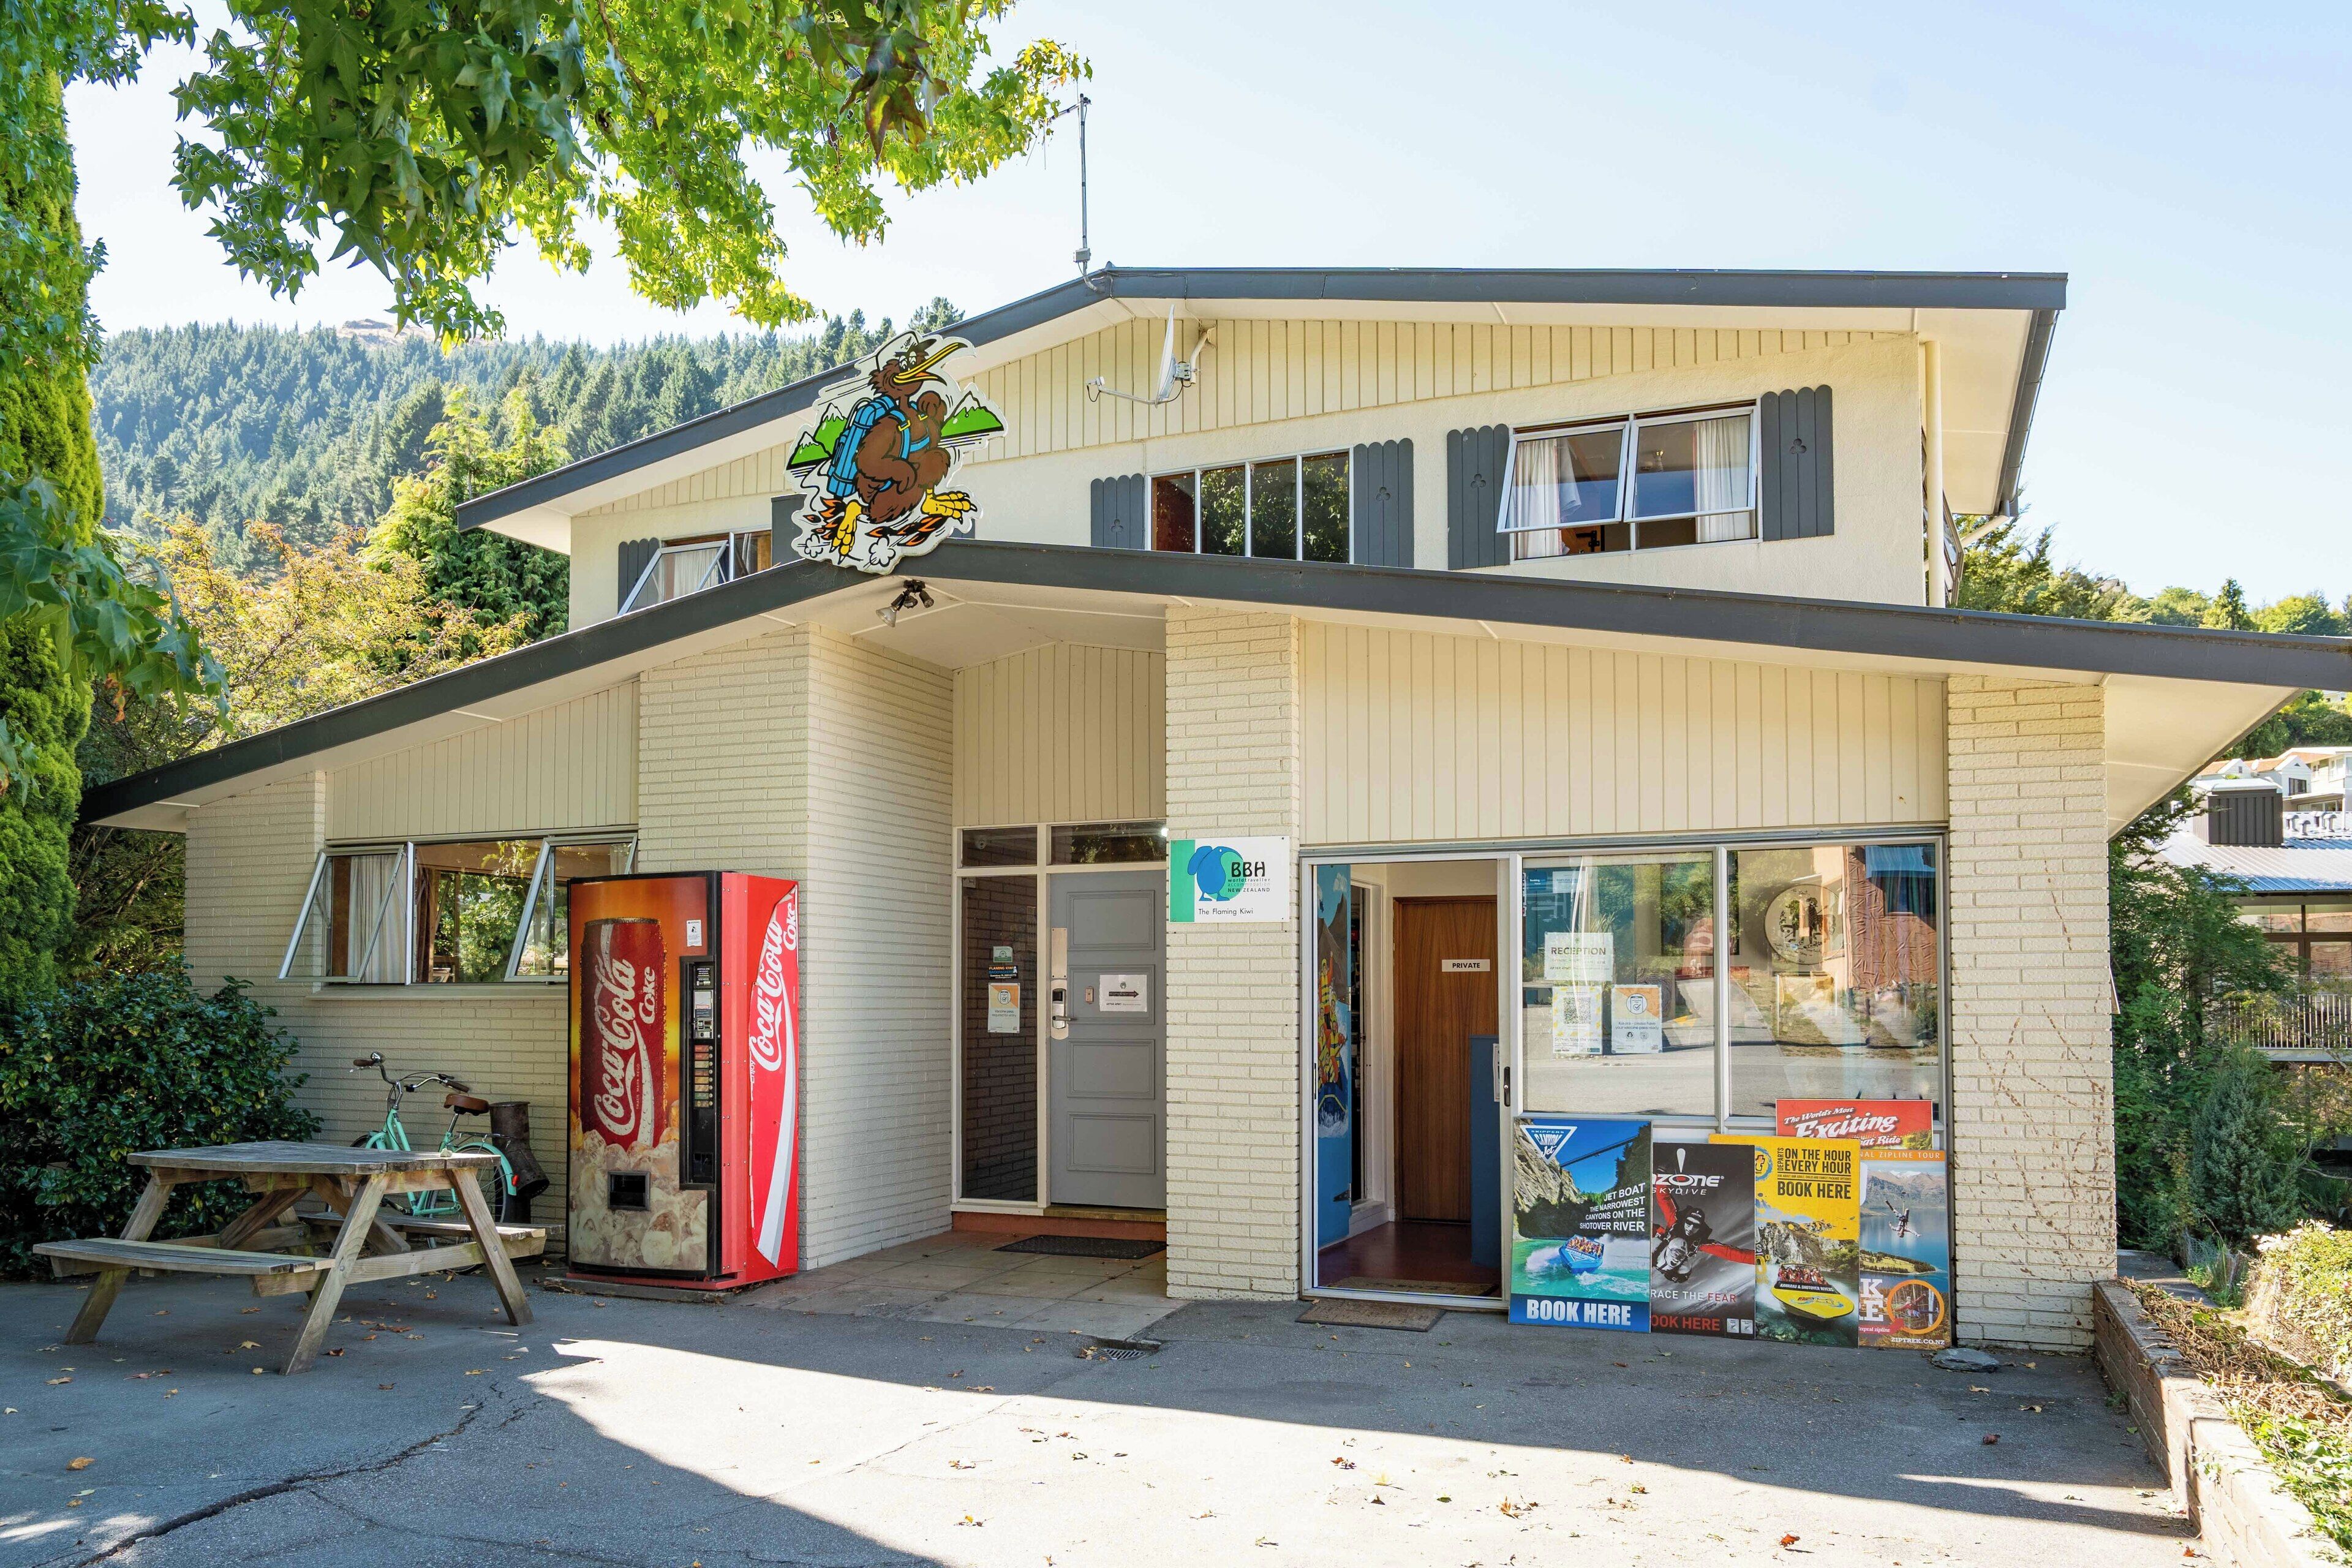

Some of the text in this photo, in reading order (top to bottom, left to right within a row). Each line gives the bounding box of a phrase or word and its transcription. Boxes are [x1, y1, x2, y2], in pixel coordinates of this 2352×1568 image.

[1231, 861, 1265, 877] BBH
[1213, 908, 1237, 916] Flaming
[783, 902, 796, 951] Coke
[639, 966, 655, 1024] Coke
[749, 920, 783, 1072] Coca-Cola
[594, 957, 636, 1136] Coca-Cola
[1784, 1115, 1800, 1125] The
[1795, 1112, 1898, 1137] Exciting
[1534, 1133, 1562, 1145] CANYON
[1876, 1136, 1901, 1145] Ride
[1541, 1145, 1556, 1157] Jet
[1785, 1148, 1851, 1161] ON THE HOUR
[1785, 1159, 1851, 1174] EVERY HOUR
[1604, 1183, 1646, 1202] JET BOAT
[1777, 1181, 1852, 1199] BOOK HERE
[1599, 1196, 1645, 1211] NARROWEST
[1585, 1212, 1611, 1220] CANYONS
[1626, 1208, 1645, 1218] THE
[1580, 1221, 1645, 1232] SHOTOVER RIVER
[1683, 1291, 1704, 1300] THE
[1708, 1292, 1736, 1302] FEAR
[1526, 1299, 1631, 1326] BOOK HERE
[1859, 1300, 1884, 1321] E
[1682, 1317, 1721, 1331] HERE
